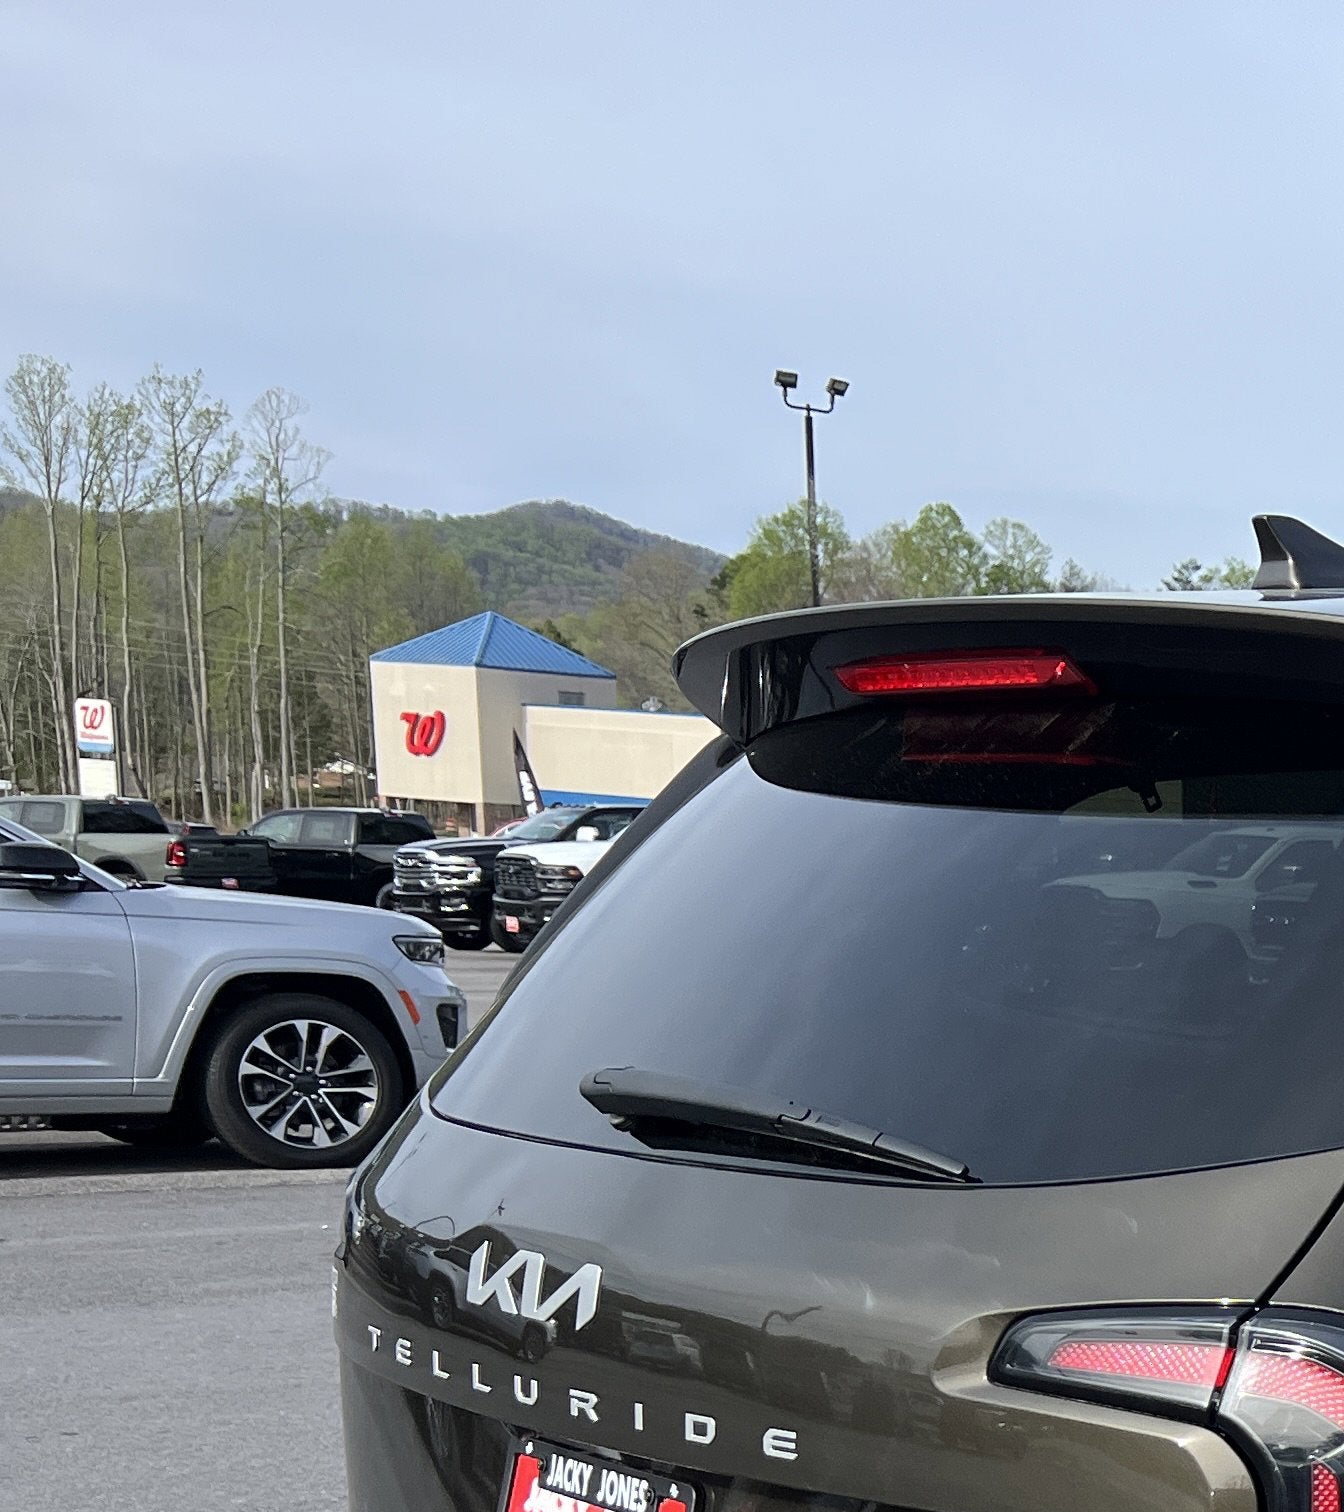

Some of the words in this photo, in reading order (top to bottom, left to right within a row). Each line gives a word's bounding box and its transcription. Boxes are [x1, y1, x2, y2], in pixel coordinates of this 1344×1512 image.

[80, 705, 105, 730] W
[400, 710, 446, 757] W
[467, 1240, 602, 1331] KIA
[367, 1324, 798, 1460] TELLURIDE
[546, 1453, 593, 1497] JACKY
